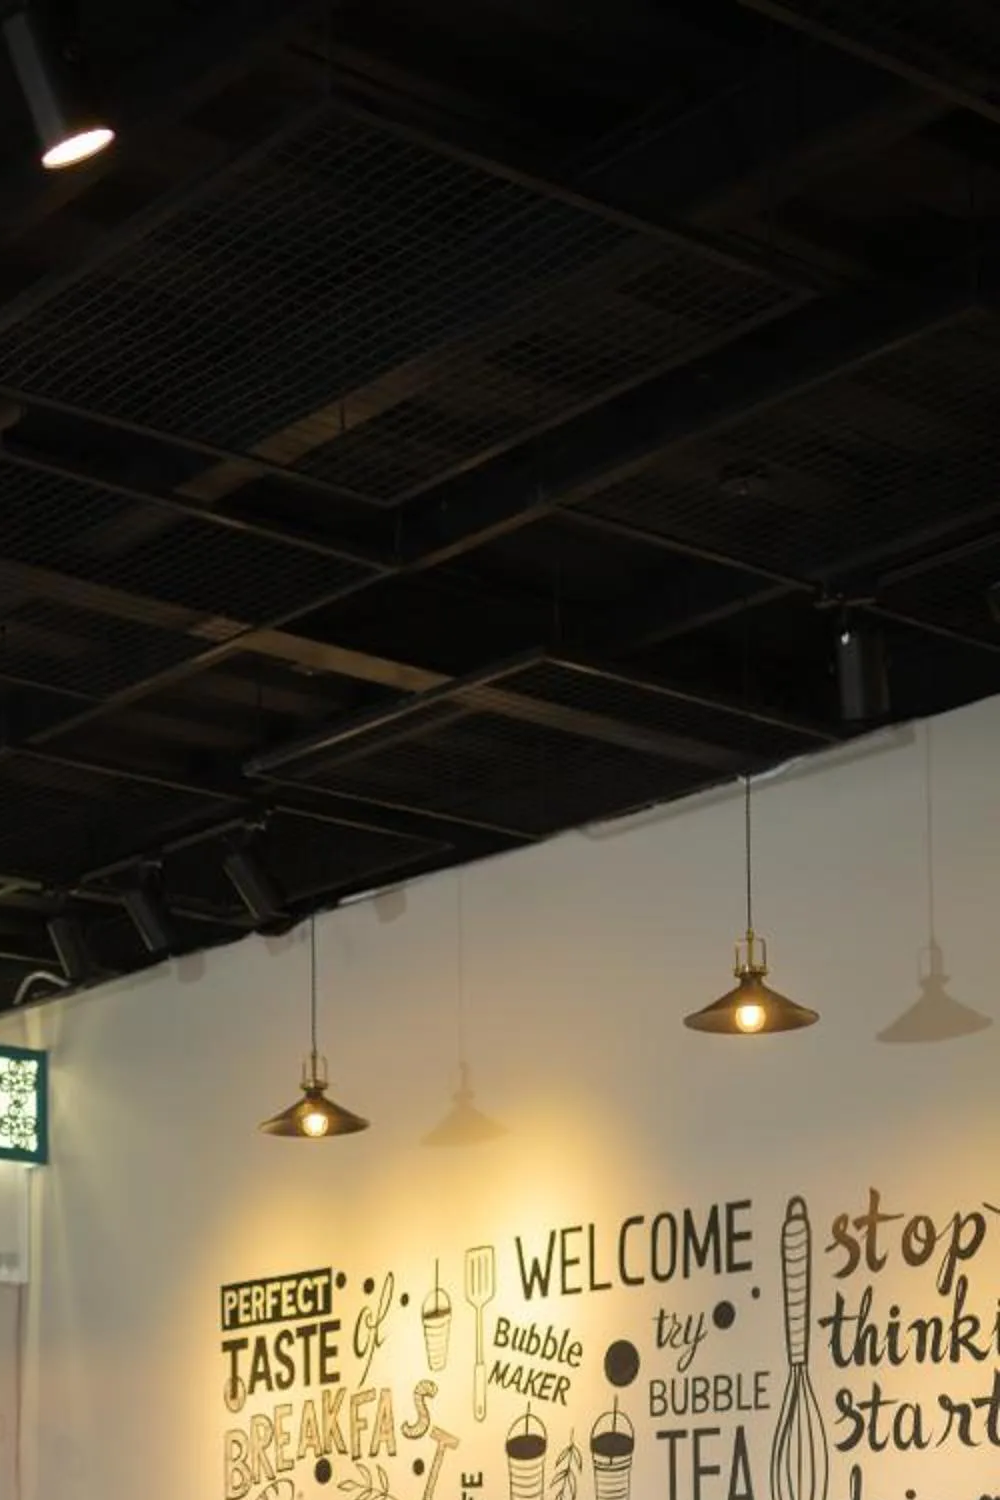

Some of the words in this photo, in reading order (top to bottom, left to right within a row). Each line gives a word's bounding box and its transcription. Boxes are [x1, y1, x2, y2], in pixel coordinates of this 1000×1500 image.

[515, 1199, 753, 1301] WELCOME
[825, 1187, 986, 1296] stop
[225, 1275, 329, 1326] PERFECT
[222, 1319, 341, 1400] TASTE
[492, 1316, 584, 1368] Bubble
[652, 1308, 708, 1373] try
[488, 1360, 571, 1406] MAKER
[649, 1371, 770, 1417] BUBBLE
[834, 1367, 1000, 1452] start
